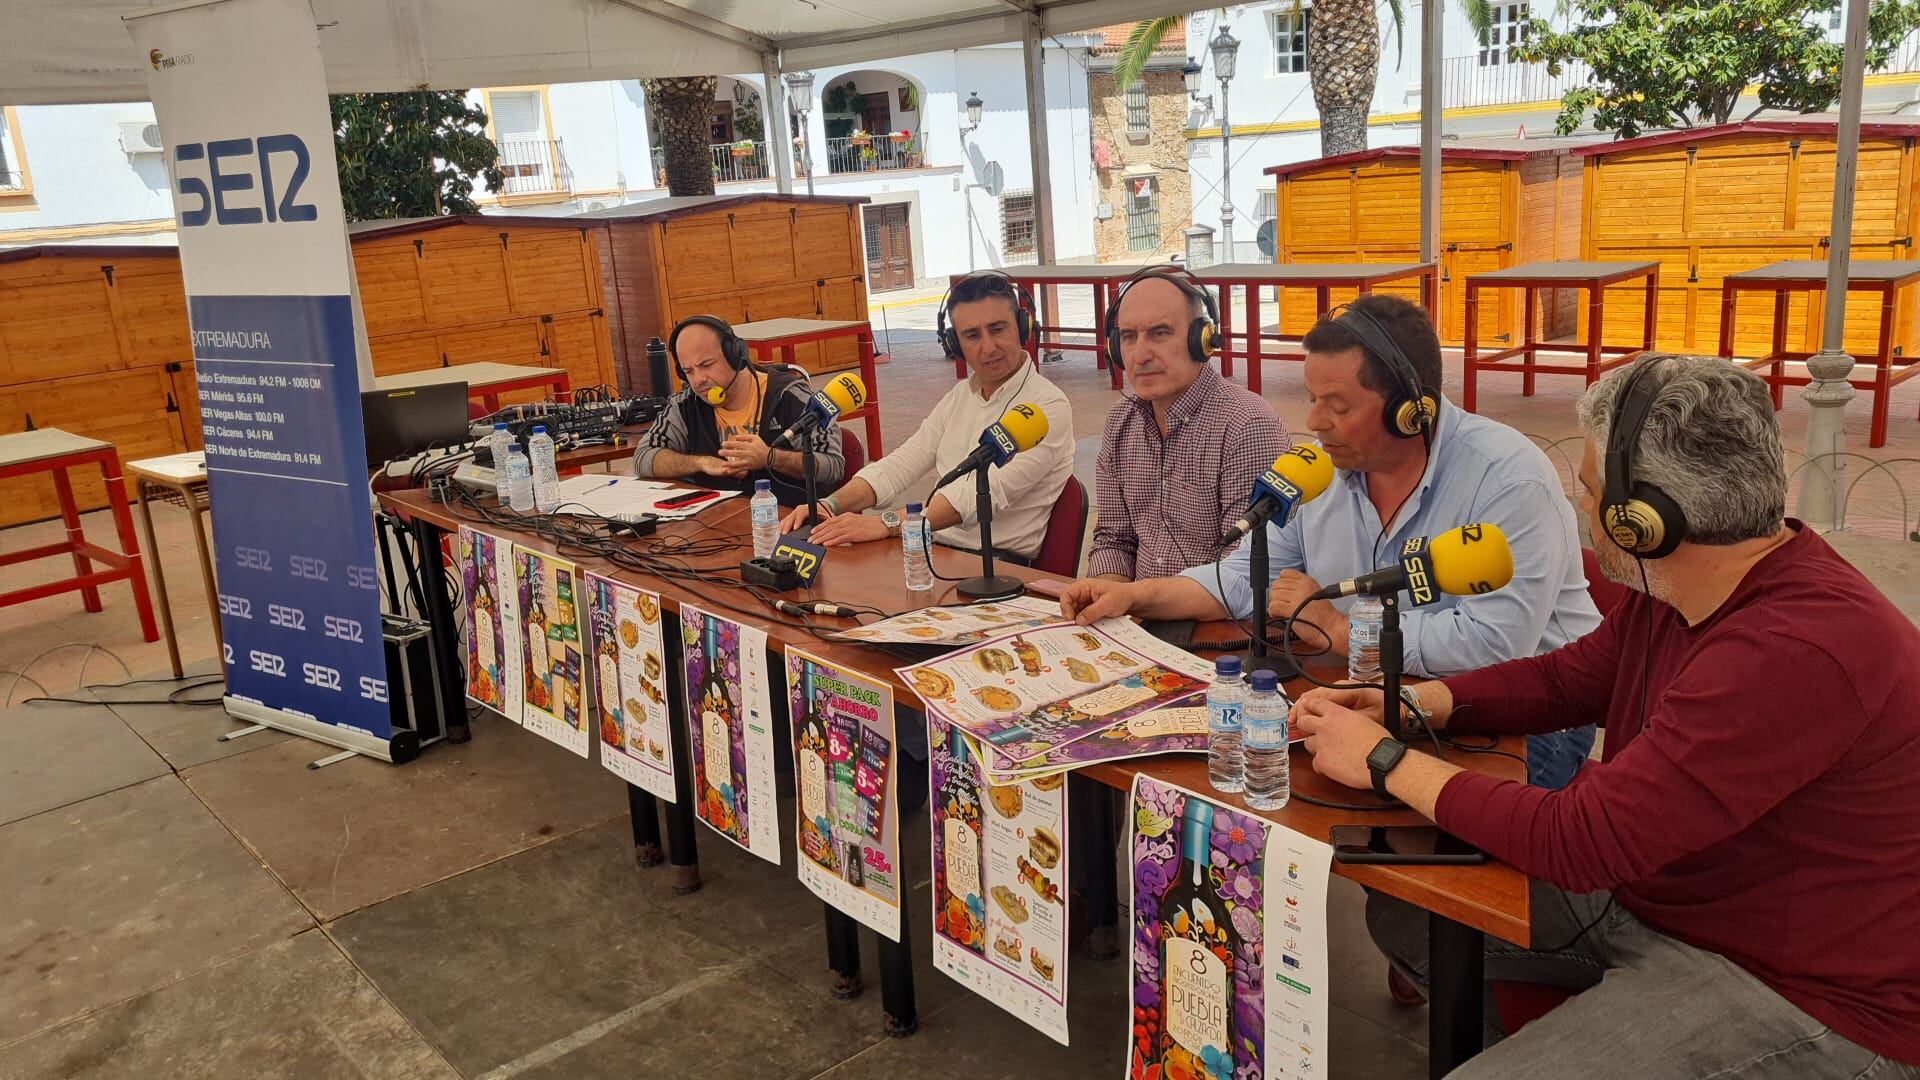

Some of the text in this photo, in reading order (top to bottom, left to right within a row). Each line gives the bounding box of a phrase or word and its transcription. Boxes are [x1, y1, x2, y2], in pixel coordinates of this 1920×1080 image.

[175, 134, 318, 226] SER
[214, 373, 257, 386] Extremadura
[259, 376, 274, 386] 94.2
[275, 377, 286, 388] FM
[838, 376, 863, 407] SER
[198, 390, 210, 400] SER
[211, 390, 234, 402] Mérida
[253, 393, 264, 404] FM
[814, 392, 838, 415] SER
[201, 408, 284, 424] SER Vegas Altas 100.0 FM
[1011, 404, 1034, 420] ER
[203, 425, 274, 440] SER Cáceres 94.4 FM
[989, 424, 1015, 454] SER
[205, 444, 217, 454] SER
[219, 445, 238, 456] Norte
[238, 448, 248, 457] de
[248, 448, 292, 462] Extremadura
[309, 454, 322, 465] FM
[1284, 446, 1318, 465] ER
[1261, 470, 1298, 499] SER
[236, 546, 272, 571] SER
[1403, 536, 1423, 555] SER
[290, 555, 328, 582] SER
[346, 566, 376, 590] SE
[1404, 556, 1432, 604] SER
[218, 594, 252, 620] SER
[268, 604, 306, 631] SER
[324, 616, 364, 644] SER
[250, 650, 286, 678] SER
[303, 662, 342, 692] SER
[360, 676, 388, 703] SE
[812, 675, 882, 707] SUPER PACK
[830, 696, 878, 722] AHORRO
[958, 826, 966, 844] 8
[1172, 964, 1220, 994] ENCUENTRO
[1172, 984, 1222, 1027] PUEBLA
